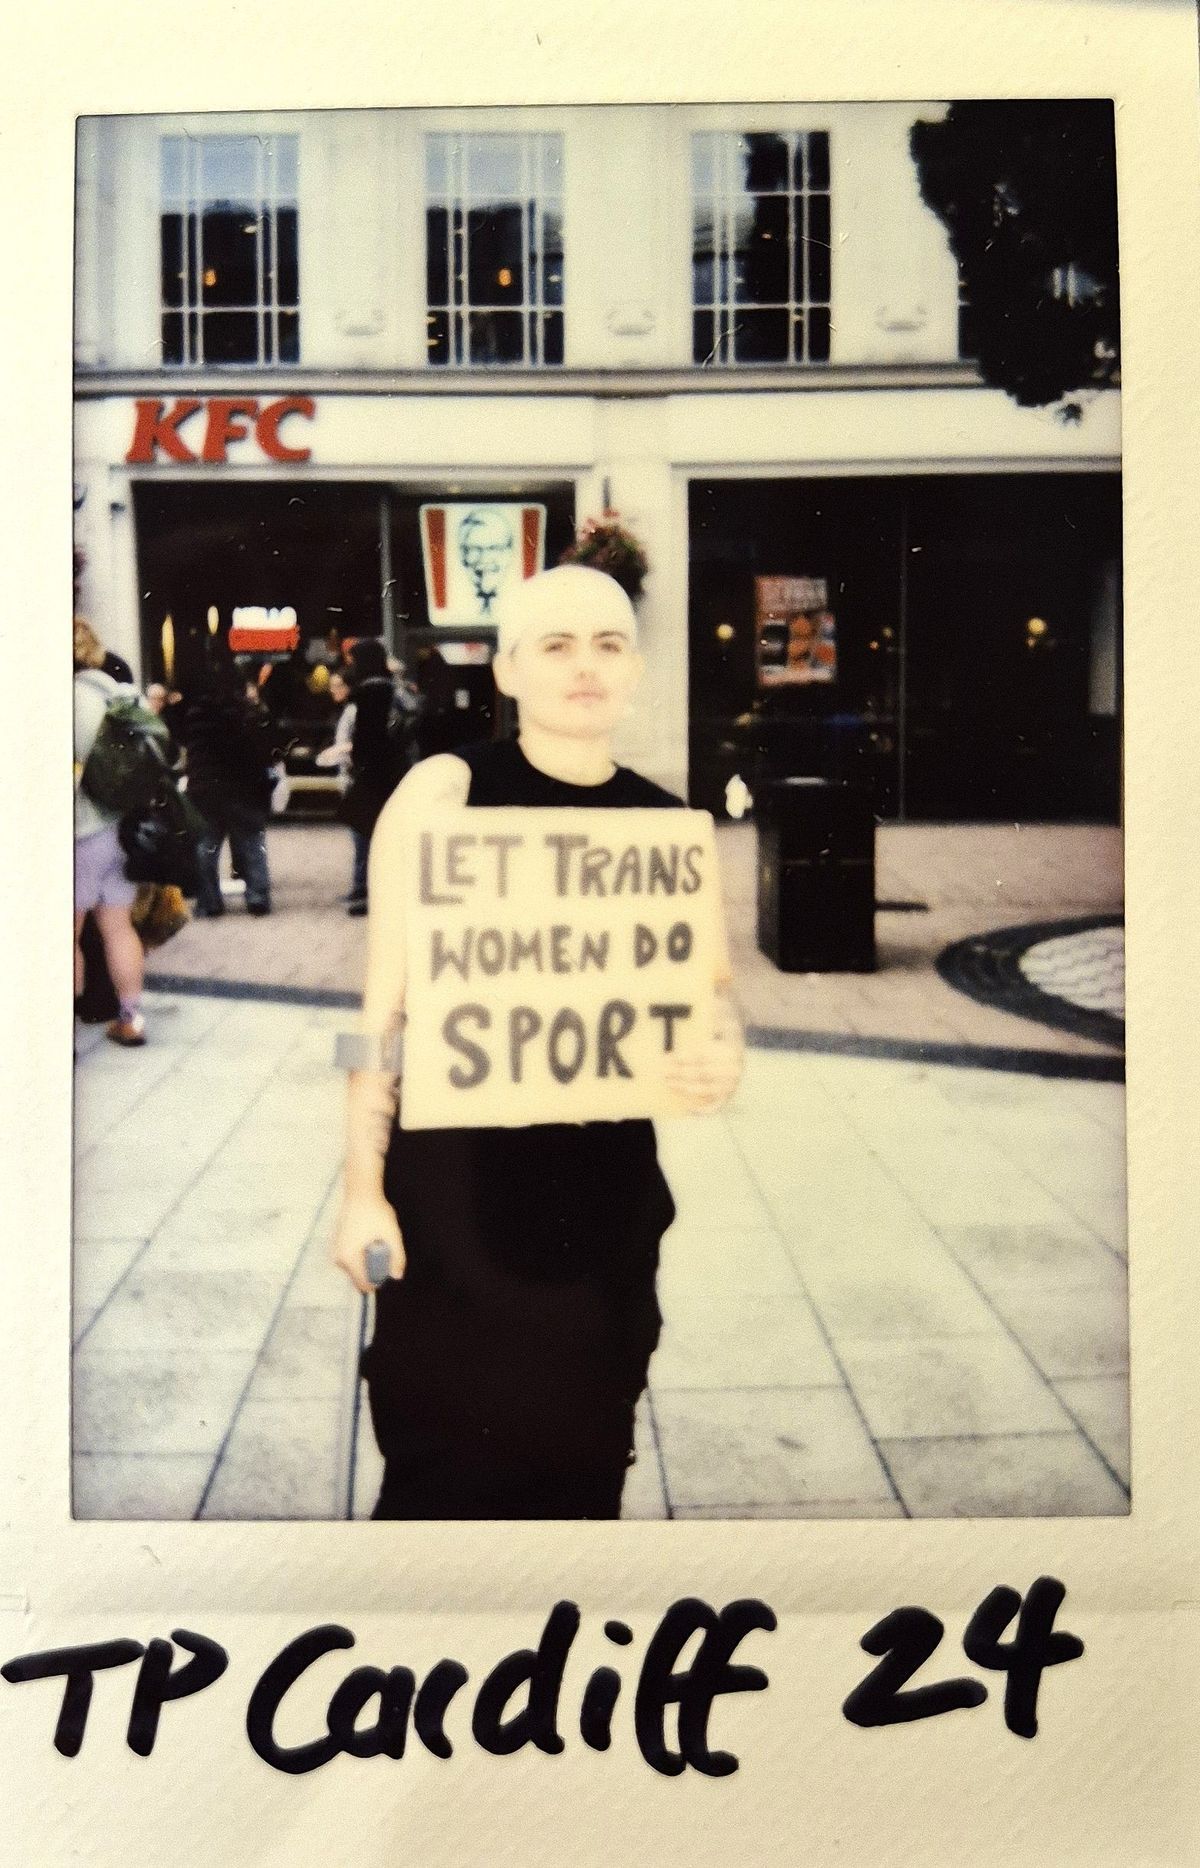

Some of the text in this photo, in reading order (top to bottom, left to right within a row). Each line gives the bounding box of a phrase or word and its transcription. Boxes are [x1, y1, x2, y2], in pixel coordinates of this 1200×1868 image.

[125, 396, 316, 464] KFC
[419, 831, 704, 906] LET TRANS
[430, 921, 694, 983] WOMEN DO
[442, 1000, 692, 1090] SPORT
[0, 1575, 1085, 1776] TP Cardiff 24
